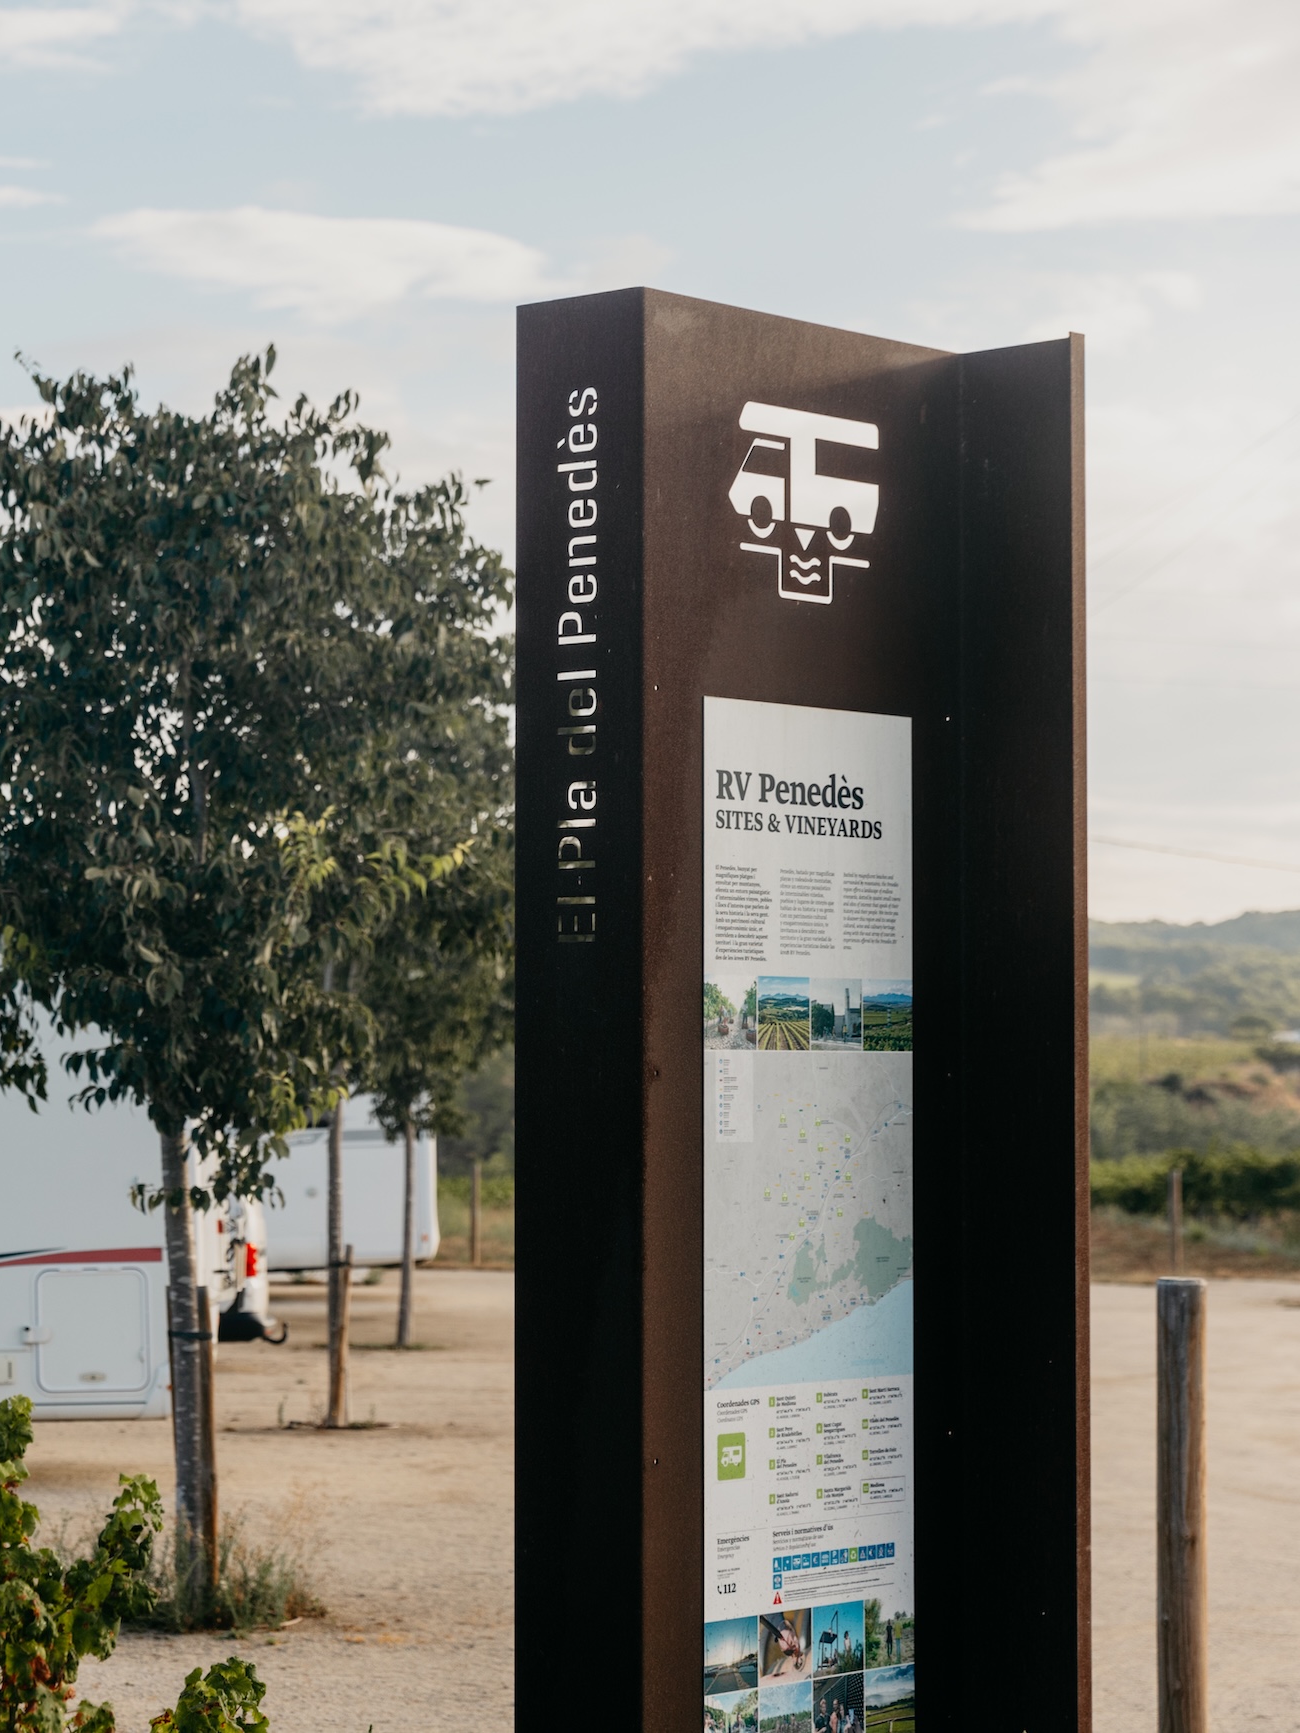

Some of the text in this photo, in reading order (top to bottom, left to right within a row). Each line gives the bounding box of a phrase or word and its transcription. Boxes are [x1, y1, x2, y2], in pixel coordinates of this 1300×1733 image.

[557, 387, 598, 943] El Pla del Penedès
[716, 769, 864, 810] RV Penedès
[715, 809, 883, 840] SITES & VINEYARDS
[723, 1582, 737, 1594] 112
